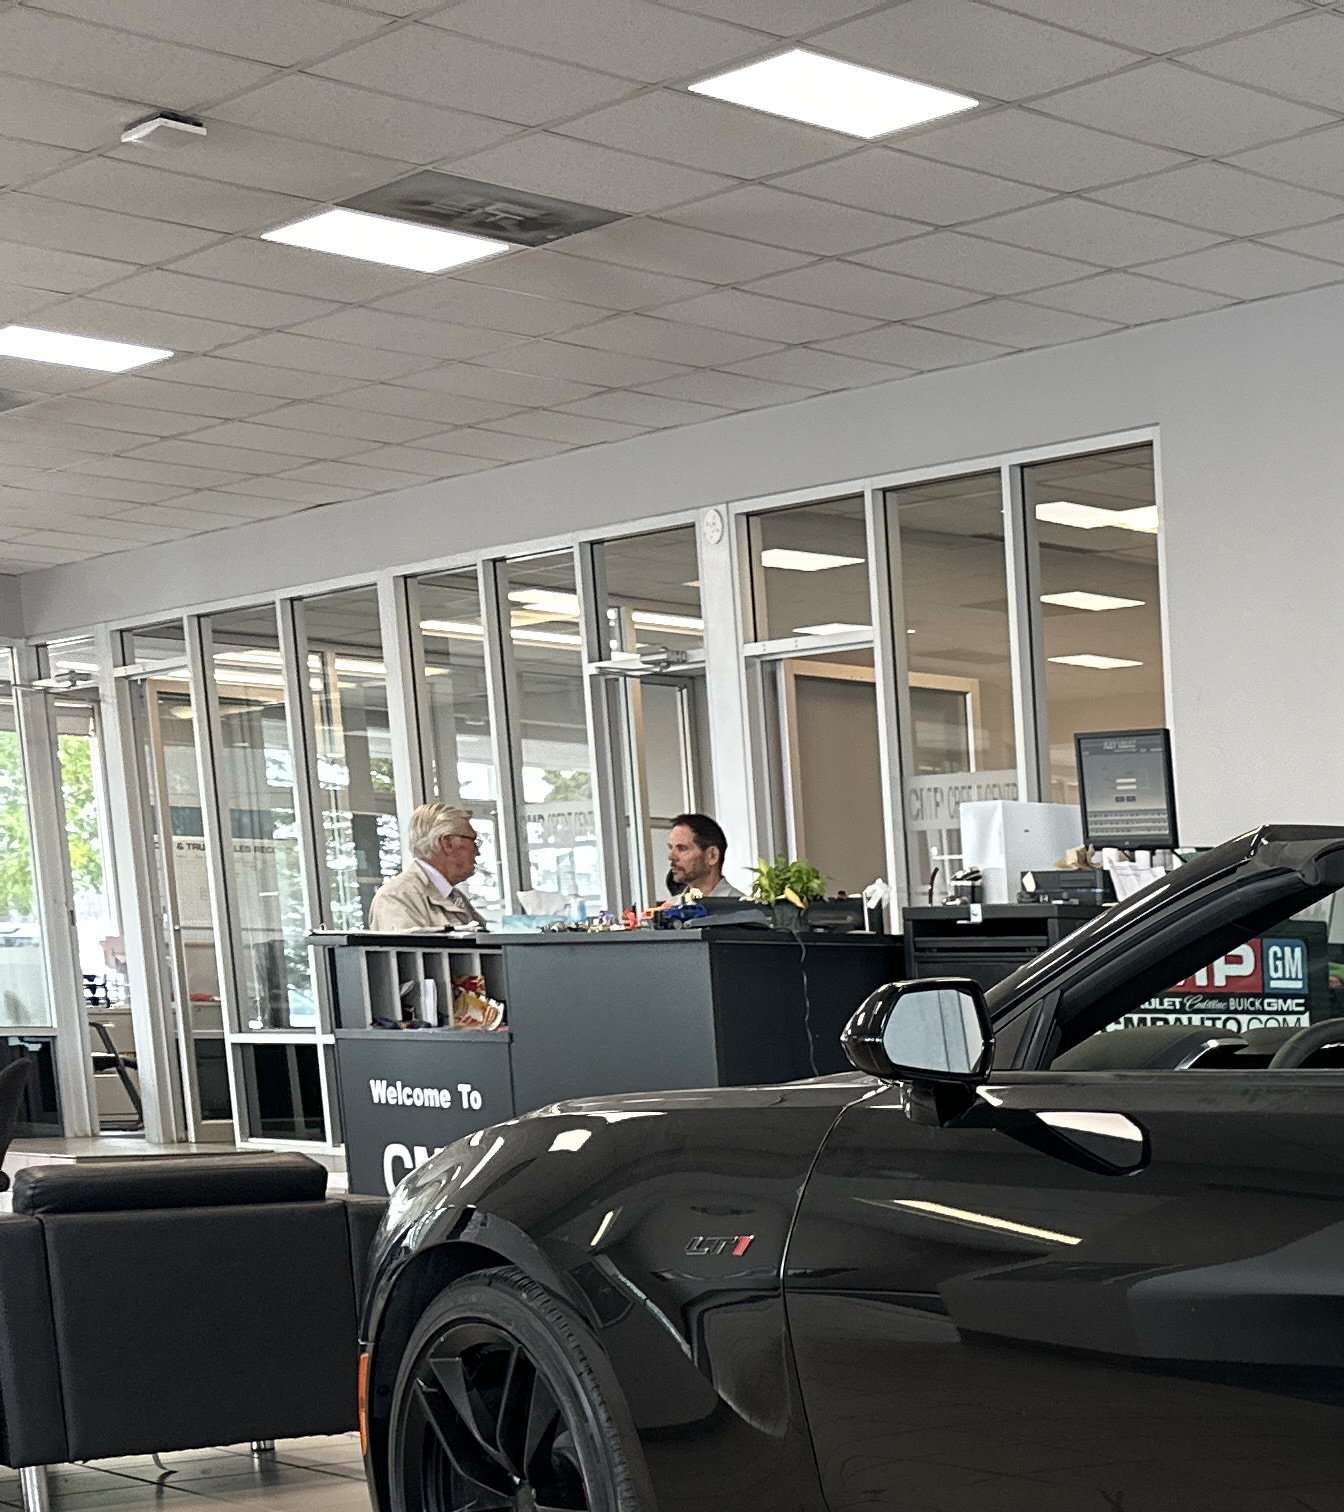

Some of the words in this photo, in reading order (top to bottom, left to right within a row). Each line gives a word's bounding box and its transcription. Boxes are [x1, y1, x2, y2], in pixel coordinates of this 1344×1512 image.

[187, 842, 206, 852] TRU
[1268, 945, 1303, 979] GM
[1229, 998, 1263, 1011] BUICK
[1263, 998, 1305, 1011] GMC
[369, 1079, 451, 1109] Welcome
[457, 1083, 482, 1110] To
[685, 1235, 755, 1255] LT1
